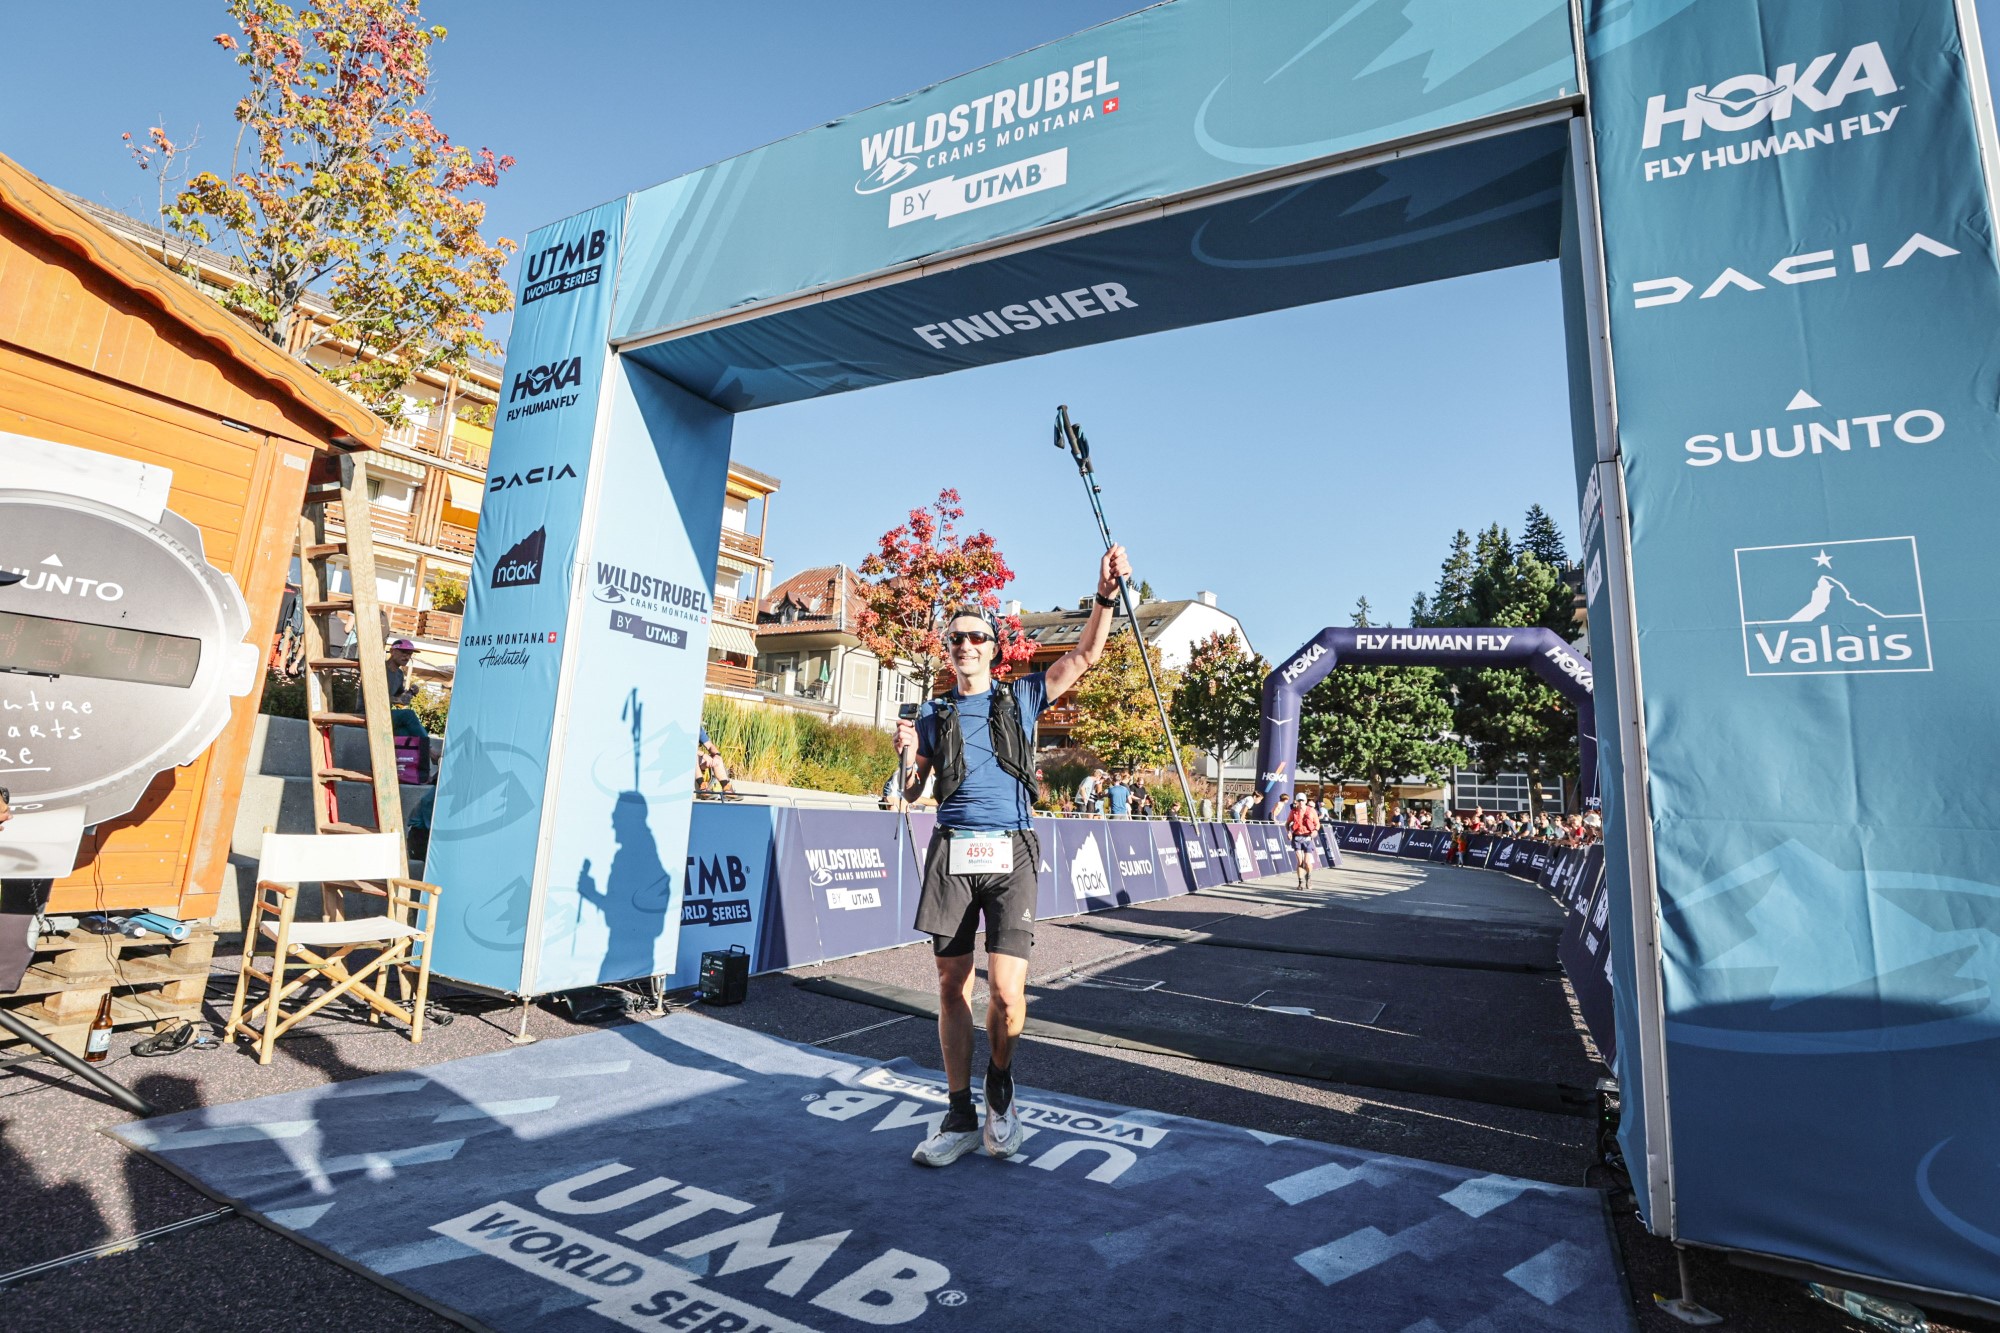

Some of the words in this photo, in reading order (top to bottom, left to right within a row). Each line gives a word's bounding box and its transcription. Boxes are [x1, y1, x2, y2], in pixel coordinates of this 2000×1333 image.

[1642, 41, 1899, 149] HOKA
[860, 56, 1120, 171] WILDSTRUBEL
[926, 138, 986, 169] CRANS
[996, 105, 1095, 147] MONTANA
[1644, 153, 1695, 182] FLY
[1701, 123, 1834, 171] HUMAN
[1840, 106, 1902, 141] FLY
[902, 189, 931, 216] BY
[964, 163, 1042, 204] UTMB
[527, 229, 606, 283] UTMB
[1633, 232, 1962, 309] DACIA
[526, 279, 560, 300] WORLD
[562, 268, 599, 290] SERIES
[912, 281, 1139, 350] FINISHER
[509, 356, 581, 403] HOKA
[507, 407, 521, 421] FLY
[521, 398, 560, 417] HUMAN
[560, 394, 579, 408] FLY
[1684, 409, 1945, 467] SUUNTO
[490, 463, 577, 493] DACIA
[496, 559, 538, 583] näak
[597, 561, 708, 614] WILDSTRUBEL
[630, 597, 658, 612] CRANS
[661, 605, 699, 623] MONTANA
[464, 634, 493, 647] CRANS
[496, 632, 544, 645] MONTANA
[616, 614, 632, 629] BY
[645, 625, 679, 644] UTMB
[1356, 635, 1390, 650] FLY
[1391, 634, 1472, 650] HUMAN
[1476, 635, 1513, 651] FLY
[1755, 624, 1913, 664] Valais
[478, 646, 531, 670] Absolutely
[1281, 643, 1327, 684] HOKA
[1544, 645, 1594, 695] HOKA
[1225, 784, 1255, 793] COUTURE
[1262, 771, 1288, 783] HOKA
[966, 847, 994, 858] 4593
[1348, 836, 1370, 844] SUUNTO
[1408, 840, 1433, 848] DACIA
[684, 852, 747, 897] TMB
[804, 847, 885, 872] WILDSTRUBEL
[1119, 859, 1153, 877] SUUNTO
[834, 873, 854, 881] CRANS
[855, 870, 882, 880] MONTANA
[1076, 867, 1106, 891] näak
[681, 904, 708, 920] RLD
[712, 904, 748, 921] SERIES
[851, 892, 874, 905] UTMB
[534, 1162, 951, 1326] UTMB
[467, 1212, 643, 1287] WORLD
[631, 1290, 773, 1333] SER
